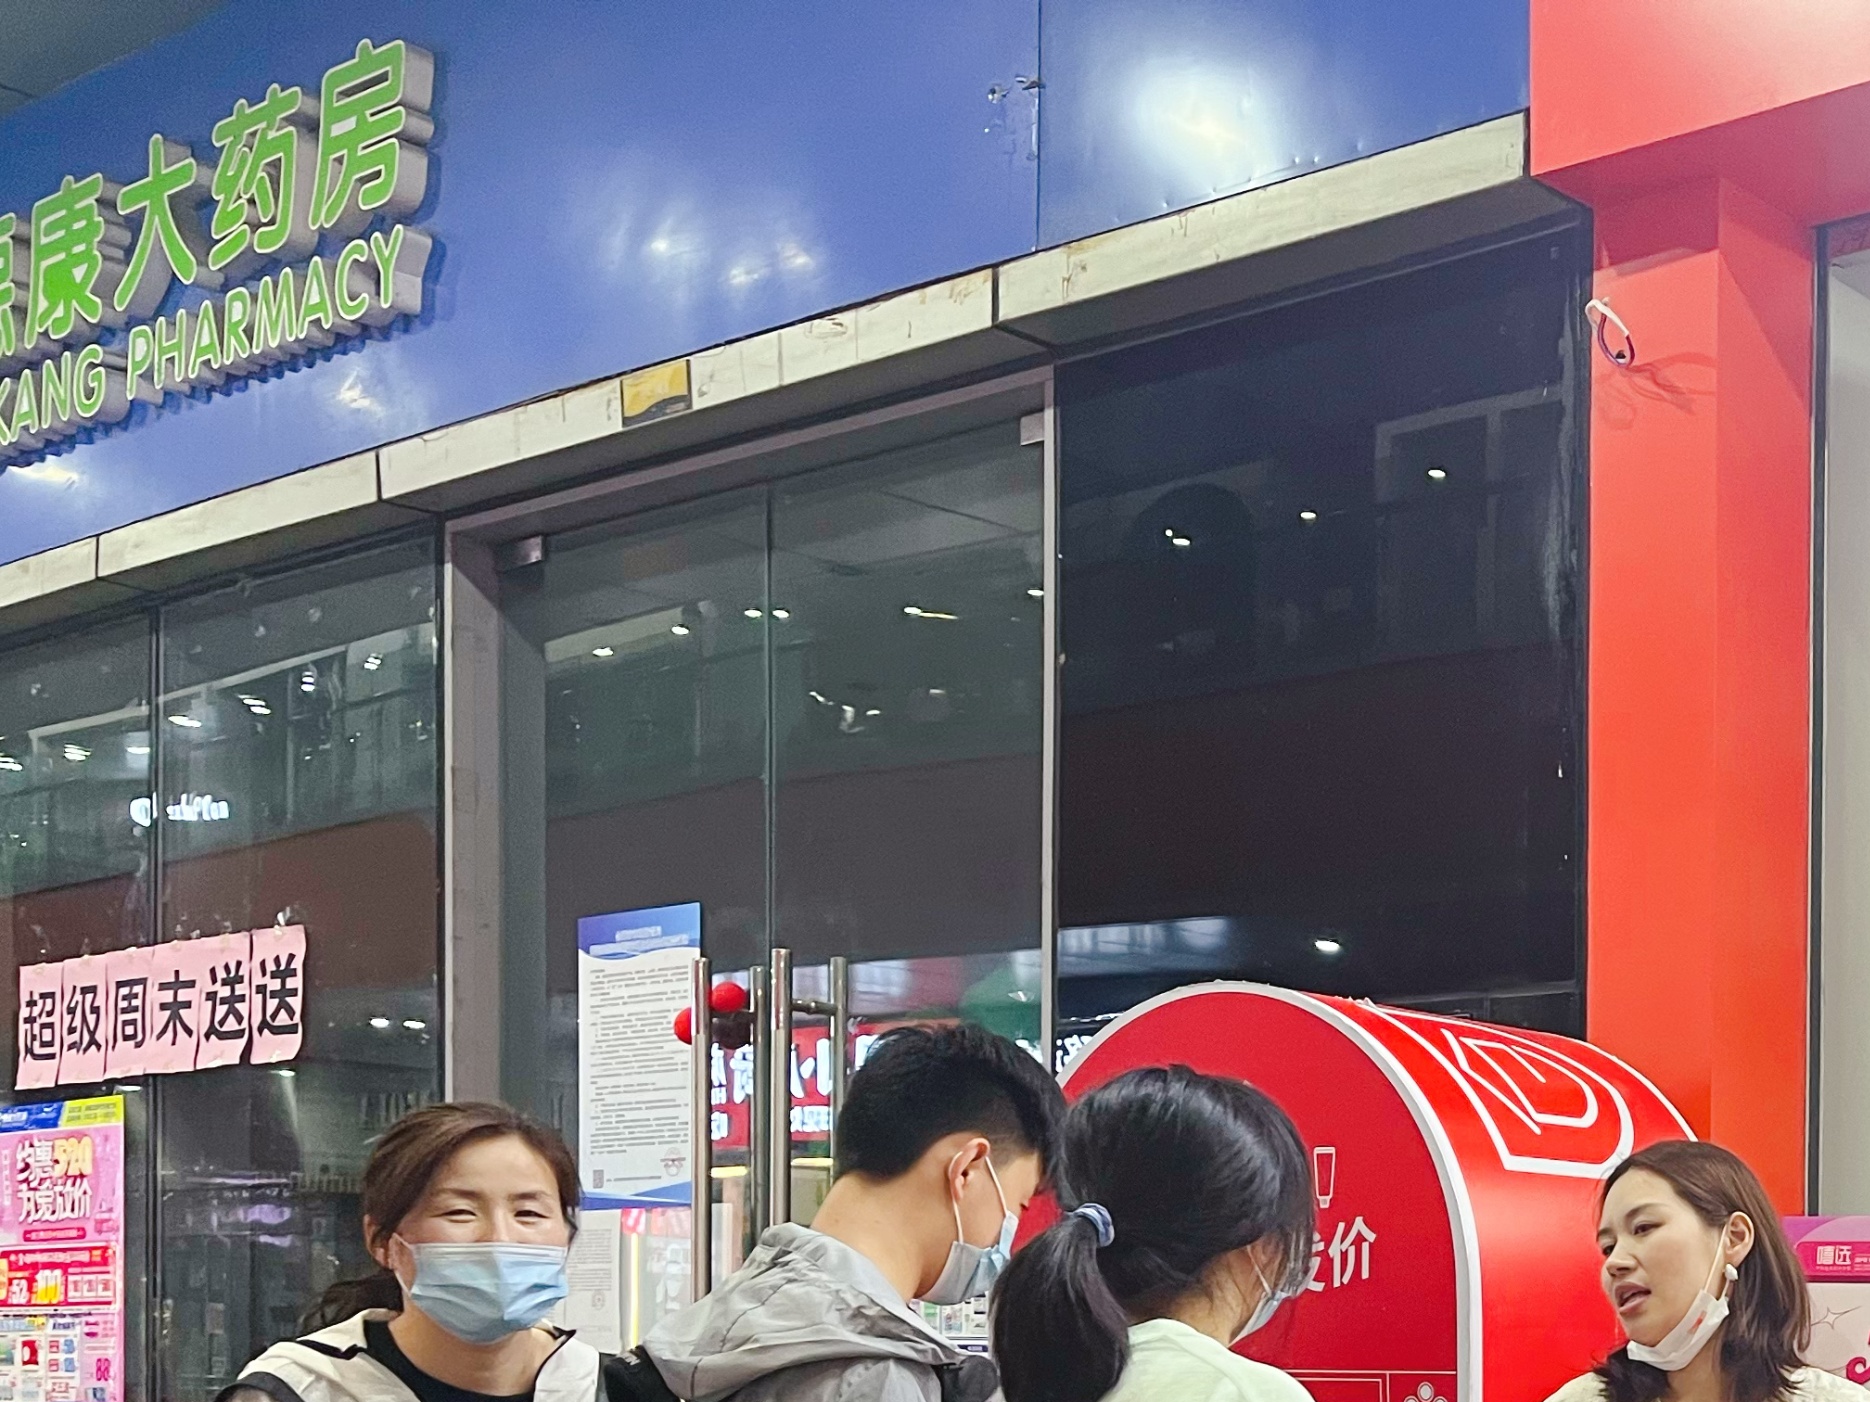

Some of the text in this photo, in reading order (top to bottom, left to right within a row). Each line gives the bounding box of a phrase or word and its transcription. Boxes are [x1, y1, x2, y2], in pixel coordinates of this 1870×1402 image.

[126, 224, 404, 400] PHARMACY
[23, 953, 299, 1063] 超级周末送送
